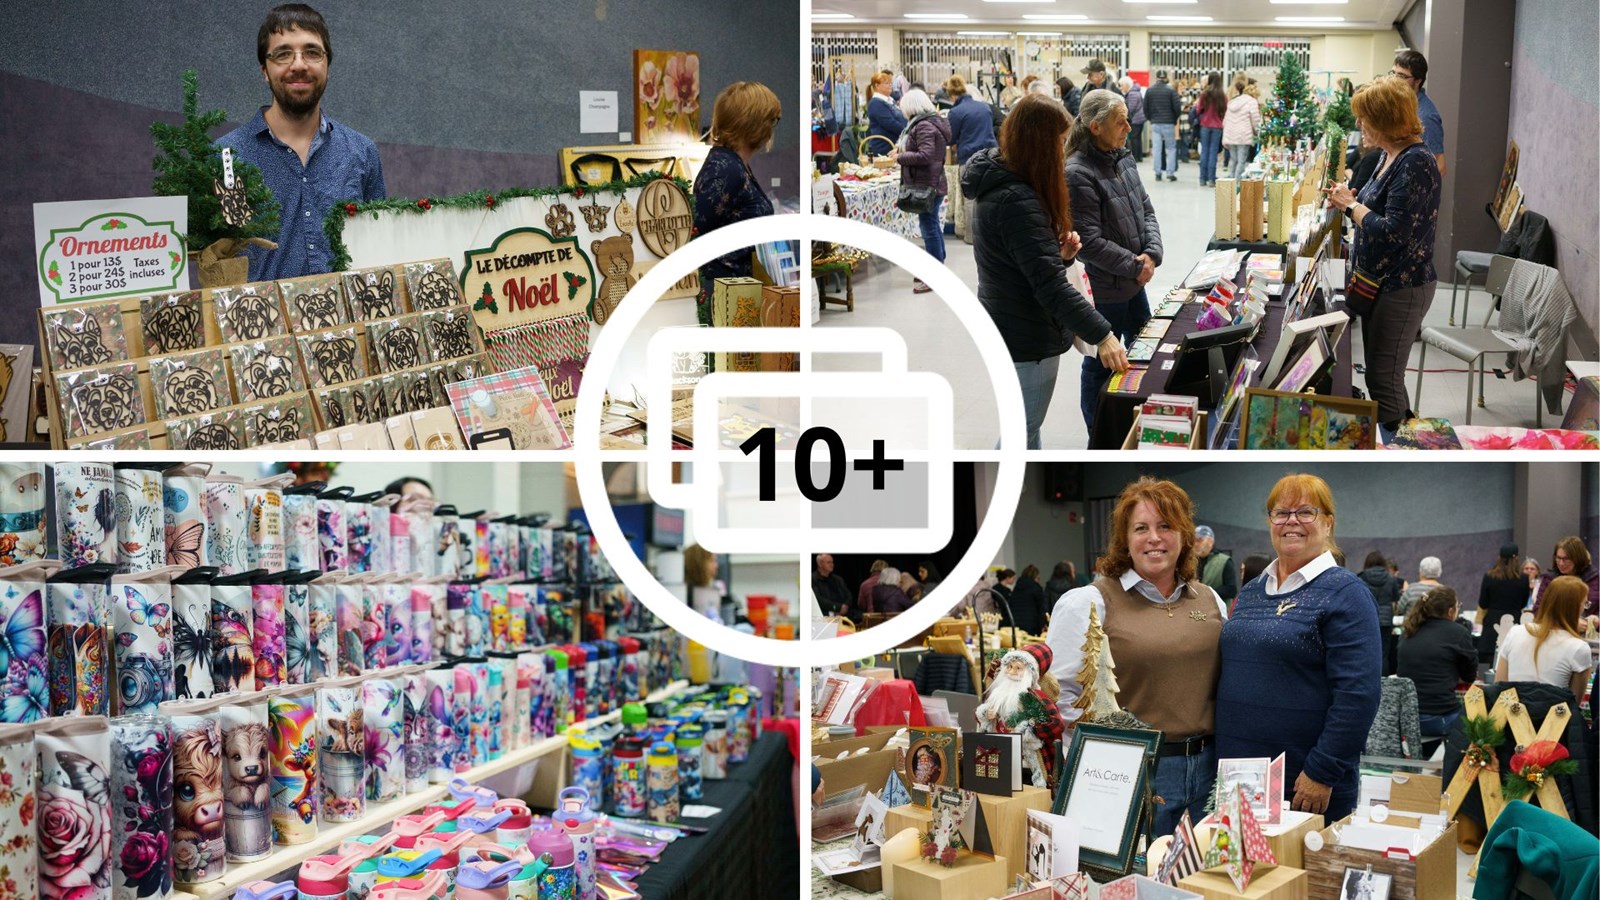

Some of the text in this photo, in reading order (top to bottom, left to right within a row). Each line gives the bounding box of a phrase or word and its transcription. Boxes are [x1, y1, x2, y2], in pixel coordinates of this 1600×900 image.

[59, 230, 168, 257] Ornements
[70, 256, 122, 272] 1 pour 13$
[133, 257, 160, 268] Taxes
[476, 247, 573, 274] LE DÉCOMPTE DE
[69, 267, 125, 284] 2 pour 24$
[129, 268, 166, 279] incluses
[69, 278, 127, 295] 3 pour 30$
[502, 273, 560, 313] Noël
